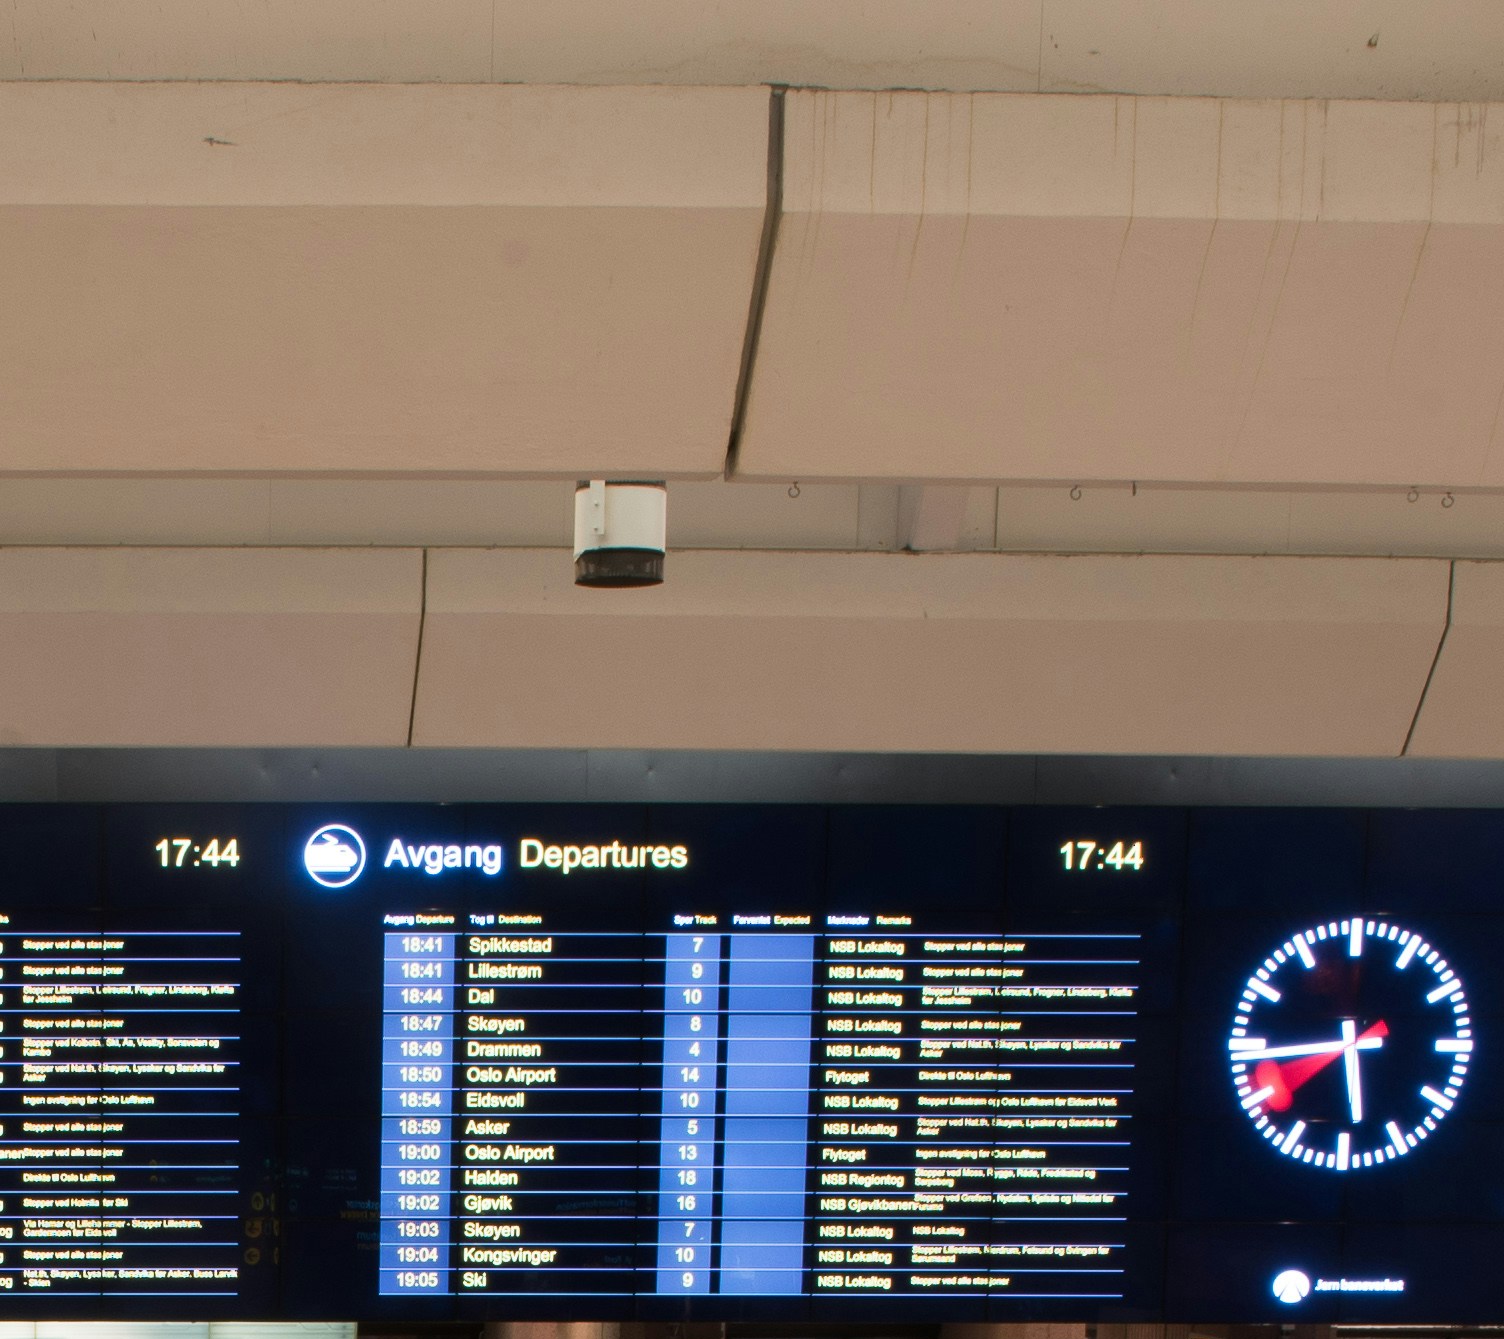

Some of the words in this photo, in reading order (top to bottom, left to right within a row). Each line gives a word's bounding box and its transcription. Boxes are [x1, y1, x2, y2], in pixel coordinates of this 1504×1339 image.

[155, 839, 240, 867] 17:44
[384, 839, 502, 875] Avgang
[520, 839, 689, 875] Departures
[1059, 841, 1144, 870] 17:44
[401, 936, 443, 953] 18:41
[469, 936, 552, 956] Spikkestad
[401, 961, 442, 979] 18:41
[468, 962, 543, 979] Lillestrøm
[400, 987, 444, 1004] 18:44
[468, 988, 495, 1004] Dal
[400, 1014, 443, 1031] 18:47
[467, 1015, 525, 1035] Skøyen
[400, 1040, 443, 1057] 18:49
[467, 1041, 542, 1057] Drammen
[399, 1066, 443, 1083] 18:50
[466, 1066, 503, 1083] Oslo
[504, 1066, 557, 1086] Airport
[399, 1091, 442, 1108] 18:54
[466, 1091, 525, 1108] Eidsvoll
[399, 1118, 442, 1135] 18:59
[465, 1119, 511, 1135] Asker
[398, 1144, 441, 1160] 19:00
[465, 1144, 501, 1160] Oslo
[503, 1144, 555, 1163] Airport
[398, 1169, 441, 1185] 19:02
[464, 1169, 519, 1185] Halden
[397, 1194, 440, 1211] 19:02
[464, 1194, 513, 1214] Gjøvik
[397, 1221, 440, 1237] 19:03
[464, 1221, 521, 1241] Skøyen
[397, 1246, 439, 1263] 19:04
[463, 1247, 557, 1266] Kongsvinger
[396, 1271, 439, 1287] 19:05
[462, 1271, 487, 1287] Ski
